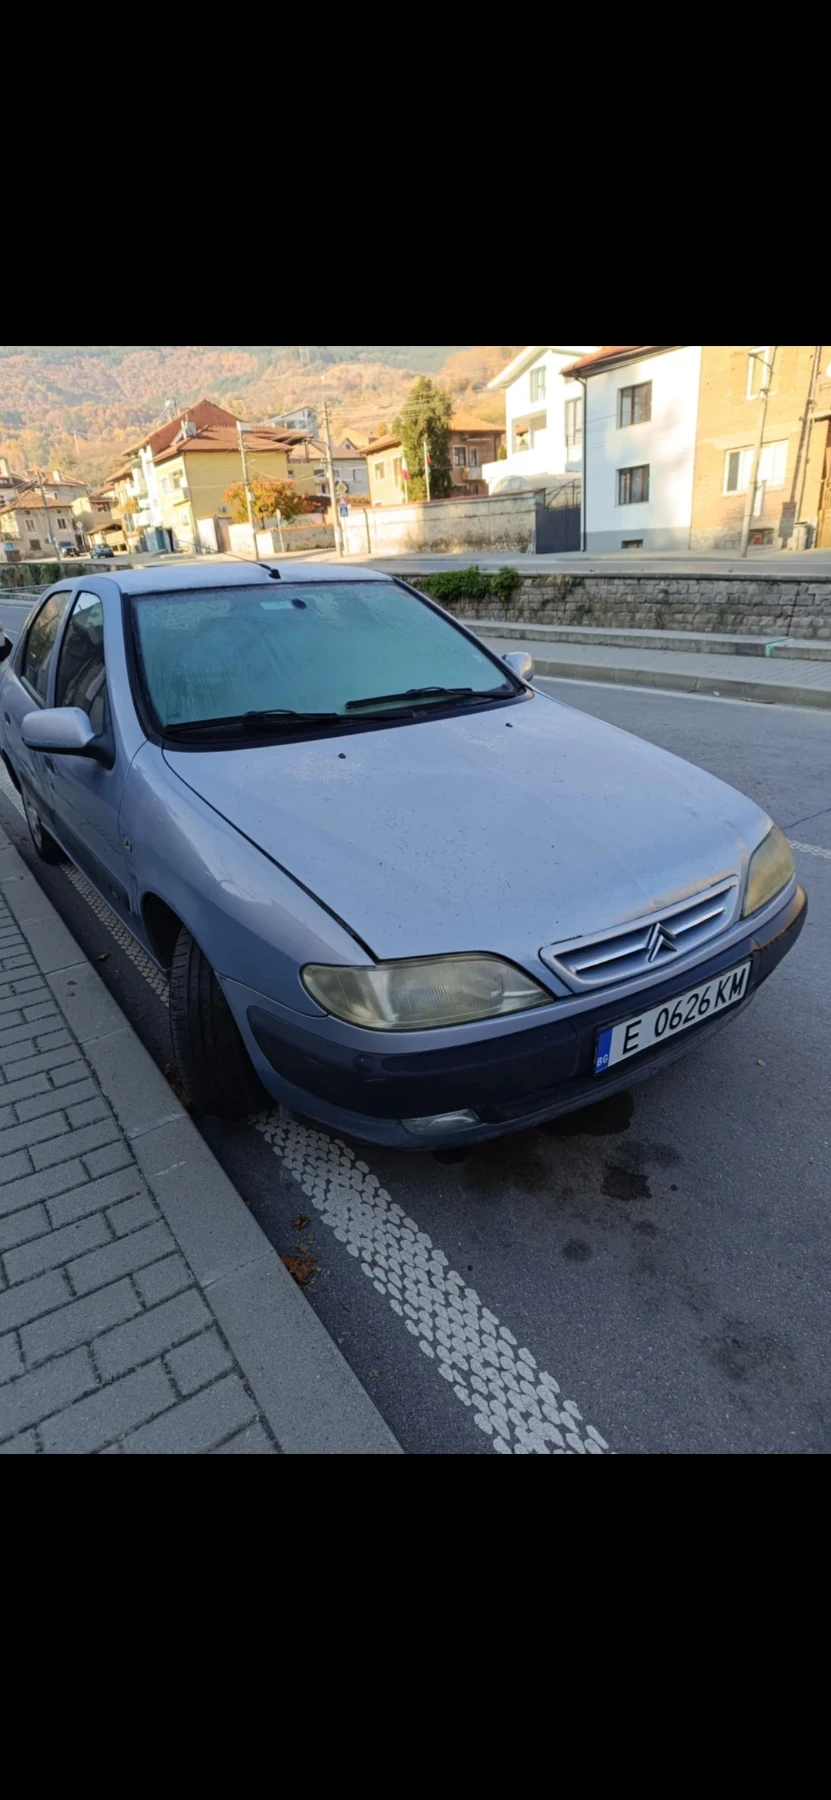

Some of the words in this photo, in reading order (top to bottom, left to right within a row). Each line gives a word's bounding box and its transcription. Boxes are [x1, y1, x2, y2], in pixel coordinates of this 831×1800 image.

[622, 1019, 642, 1055] E
[654, 985, 711, 1038] 0626
[714, 968, 747, 1008] KM
[596, 1054, 609, 1067] BG
